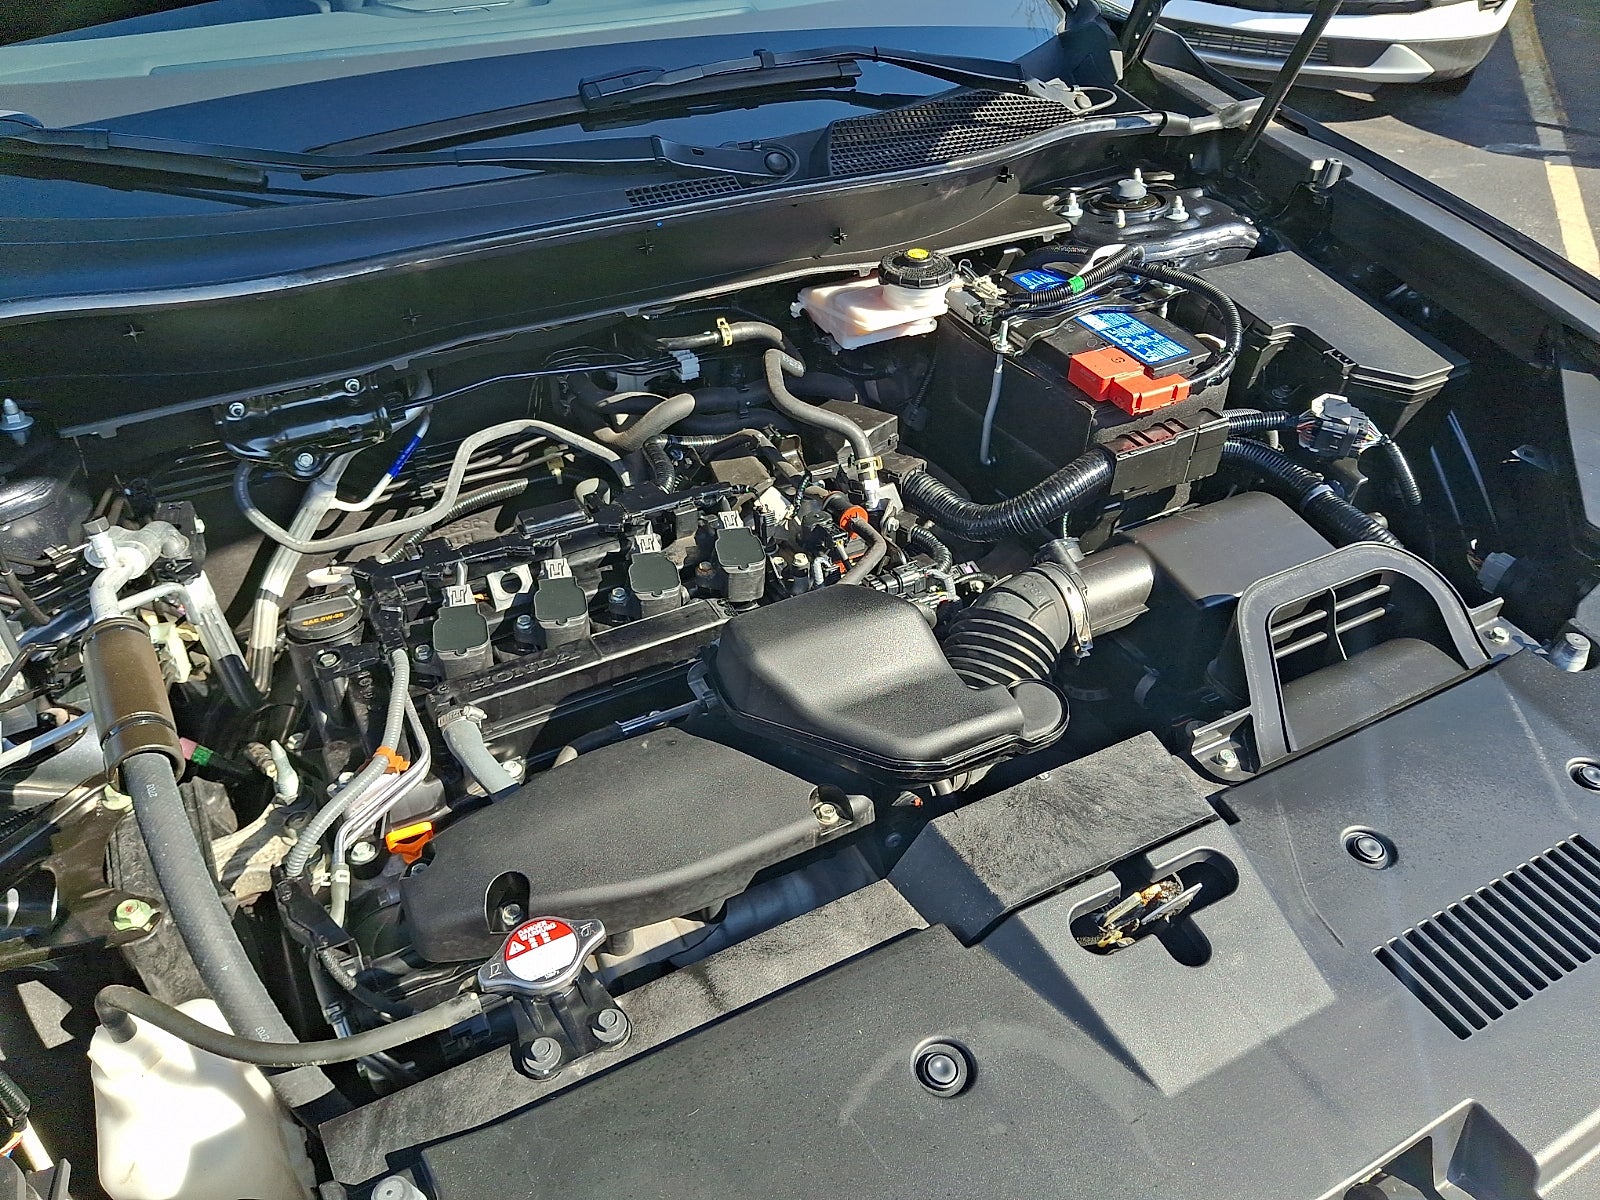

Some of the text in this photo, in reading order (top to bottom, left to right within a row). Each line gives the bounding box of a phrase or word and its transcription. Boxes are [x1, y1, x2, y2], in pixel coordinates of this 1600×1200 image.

[302, 618, 319, 627] SAE
[468, 654, 580, 692] HONDA
[518, 920, 548, 935] DANGER
[521, 922, 557, 941] WARNING
